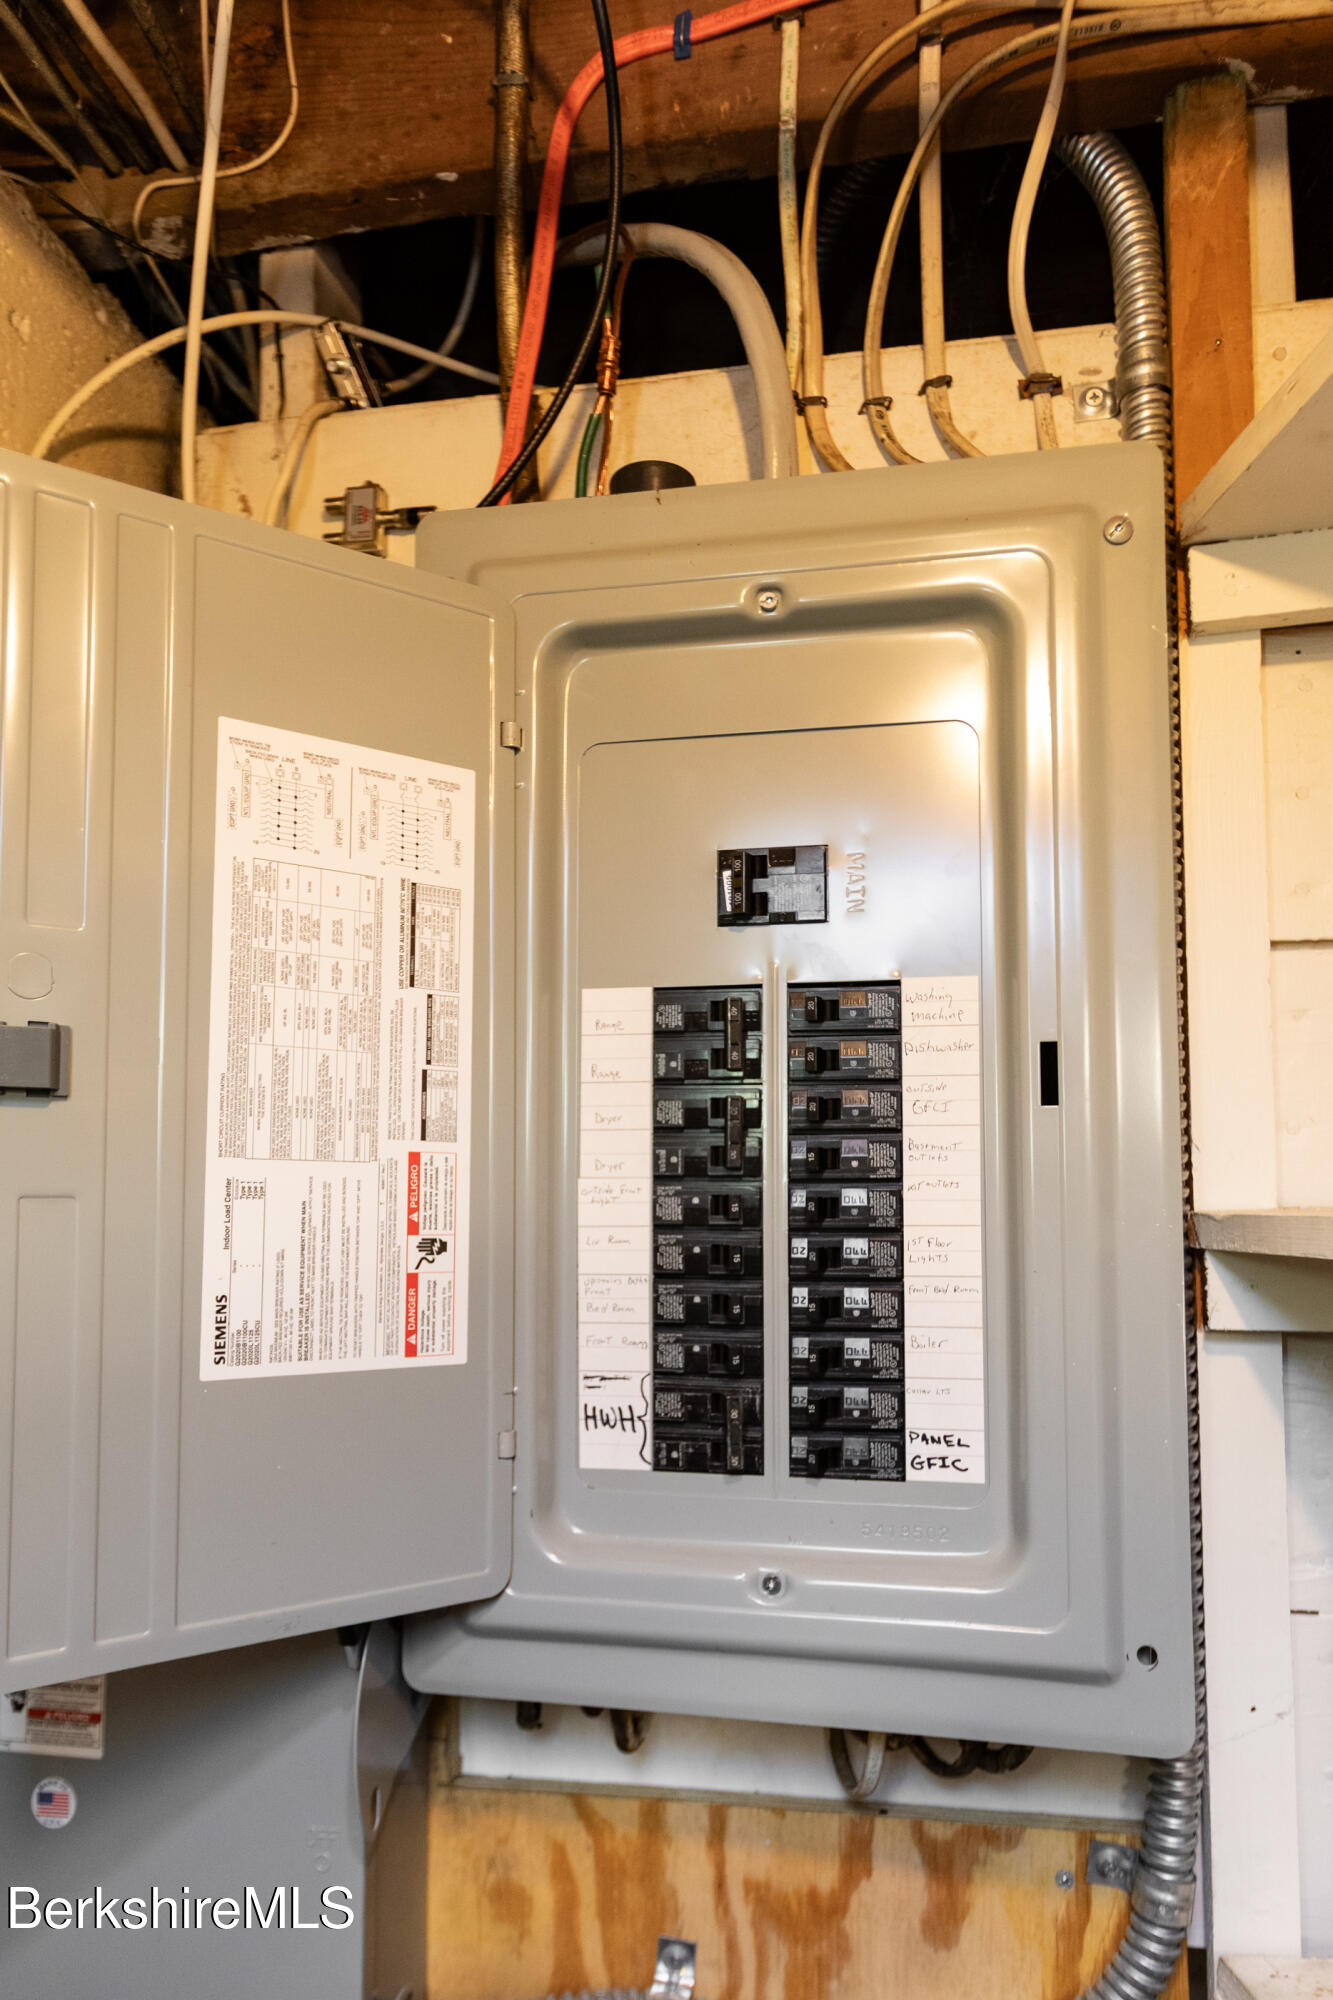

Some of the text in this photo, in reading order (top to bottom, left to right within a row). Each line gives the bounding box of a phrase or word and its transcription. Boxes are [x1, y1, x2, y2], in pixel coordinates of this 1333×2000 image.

[734, 859, 742, 872] 100
[845, 852, 866, 913] MAIN
[734, 892, 742, 905] 100
[808, 1000, 815, 1010] 20
[808, 1052, 815, 1062] 20
[809, 1102, 816, 1112] 20
[912, 1099, 953, 1115] GFCI
[808, 1152, 815, 1161] 15
[224, 1178, 232, 1202] Center
[410, 1164, 418, 1208] PELIGRO
[731, 1203, 739, 1212] 15
[223, 1226, 231, 1250] Indoor
[733, 1254, 741, 1263] 15
[298, 1297, 304, 1305] AS
[408, 1288, 416, 1330] DANGER
[733, 1304, 740, 1314] 15
[809, 1303, 816, 1312] 15
[214, 1294, 227, 1365] SIEMENS
[733, 1355, 740, 1364] 15
[810, 1354, 816, 1363] 15
[809, 1404, 816, 1414] 15
[584, 1403, 636, 1434] HWH
[909, 1431, 970, 1449] PANEL
[910, 1455, 969, 1473] GFIC
